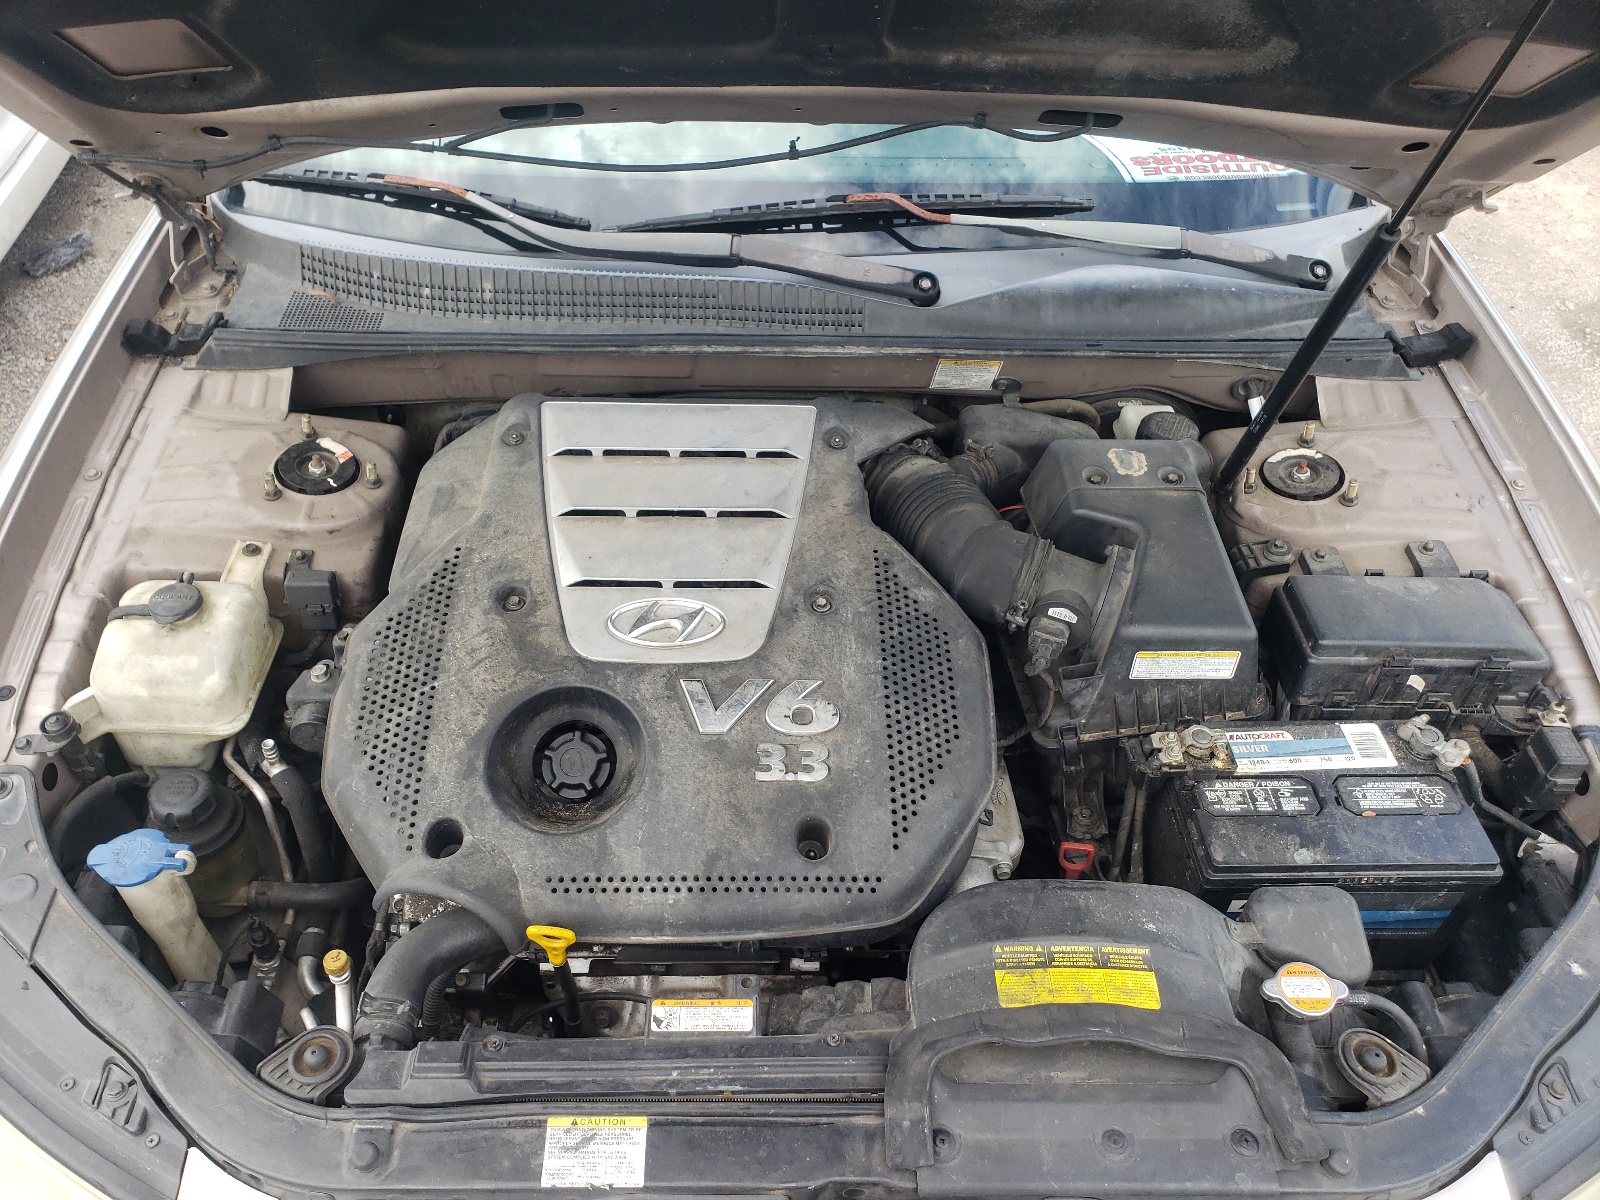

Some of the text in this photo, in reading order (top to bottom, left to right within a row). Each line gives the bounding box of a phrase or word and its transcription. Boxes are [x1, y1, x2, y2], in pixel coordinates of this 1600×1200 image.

[680, 679, 840, 736] V6
[1234, 732, 1285, 741] AUTOCRAFT
[1232, 744, 1270, 754] SILVER
[755, 743, 829, 782] 3.3
[1101, 946, 1150, 955] AVERTISSEMENT
[579, 1118, 626, 1126] CAUTION
